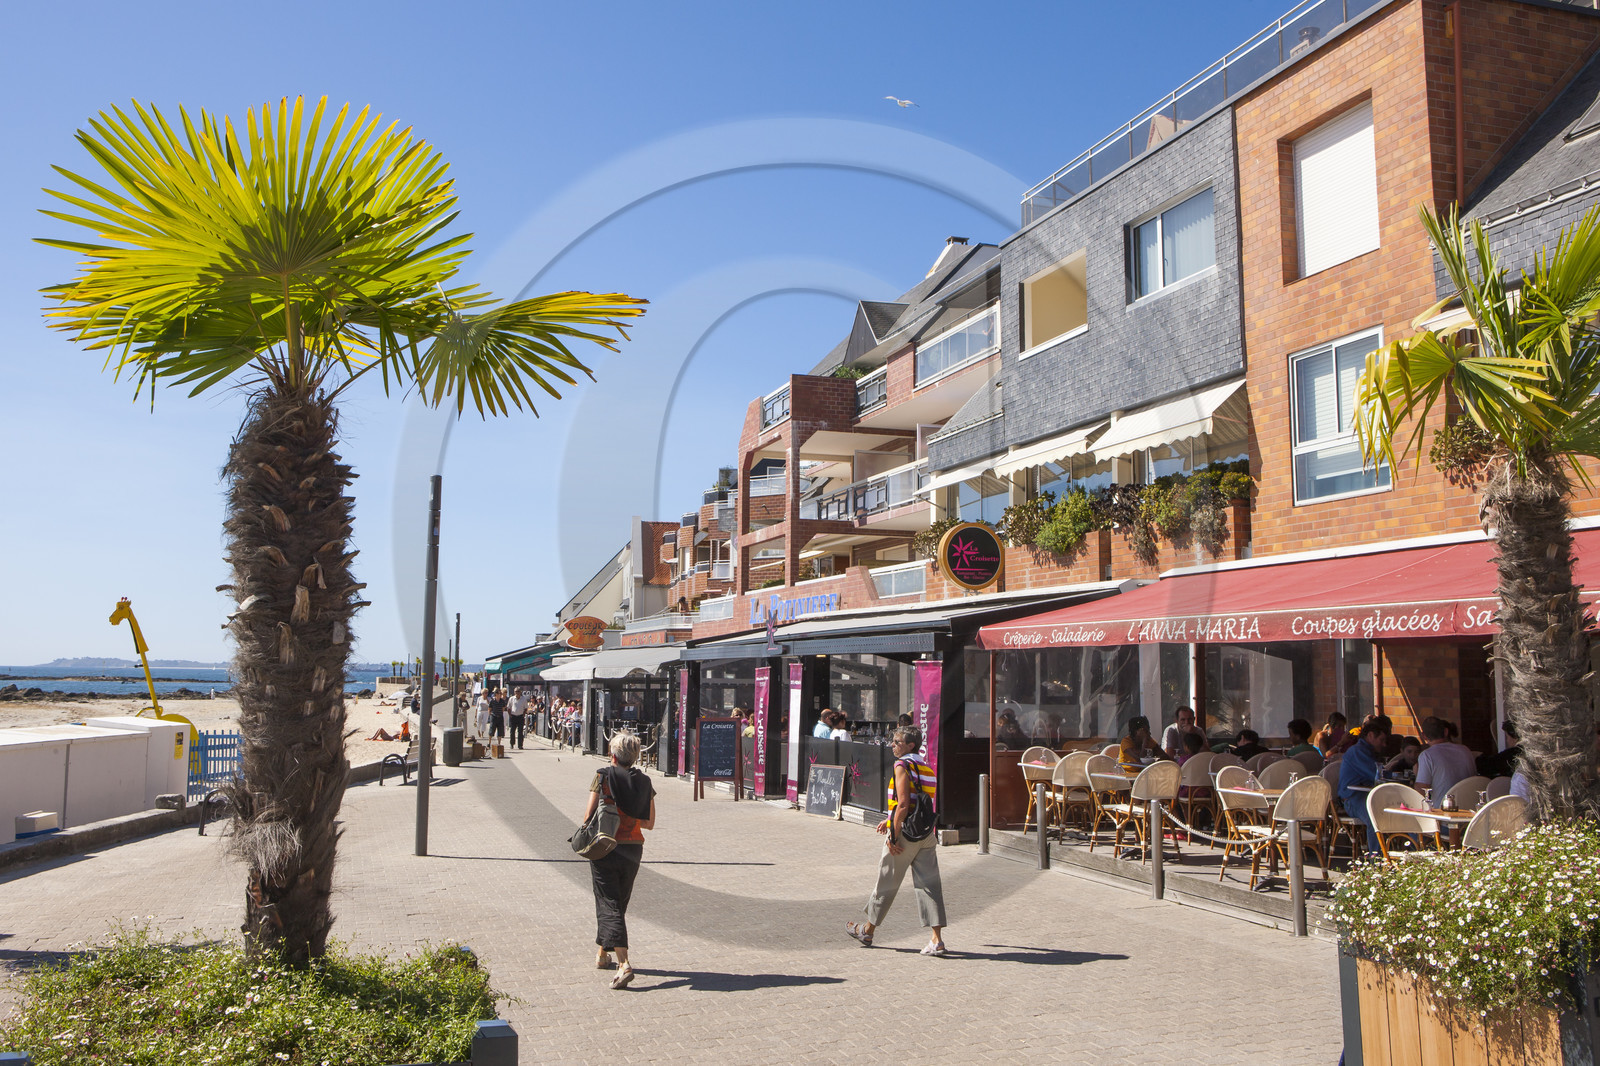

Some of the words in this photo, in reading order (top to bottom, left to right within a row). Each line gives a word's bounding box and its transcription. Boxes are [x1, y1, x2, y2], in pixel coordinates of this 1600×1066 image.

[568, 622, 603, 631] COULEUR
[1003, 631, 1042, 648] Crêperie
[1049, 627, 1106, 644] Saladerie
[1291, 616, 1359, 639] Coupes
[1361, 609, 1444, 639] glacées
